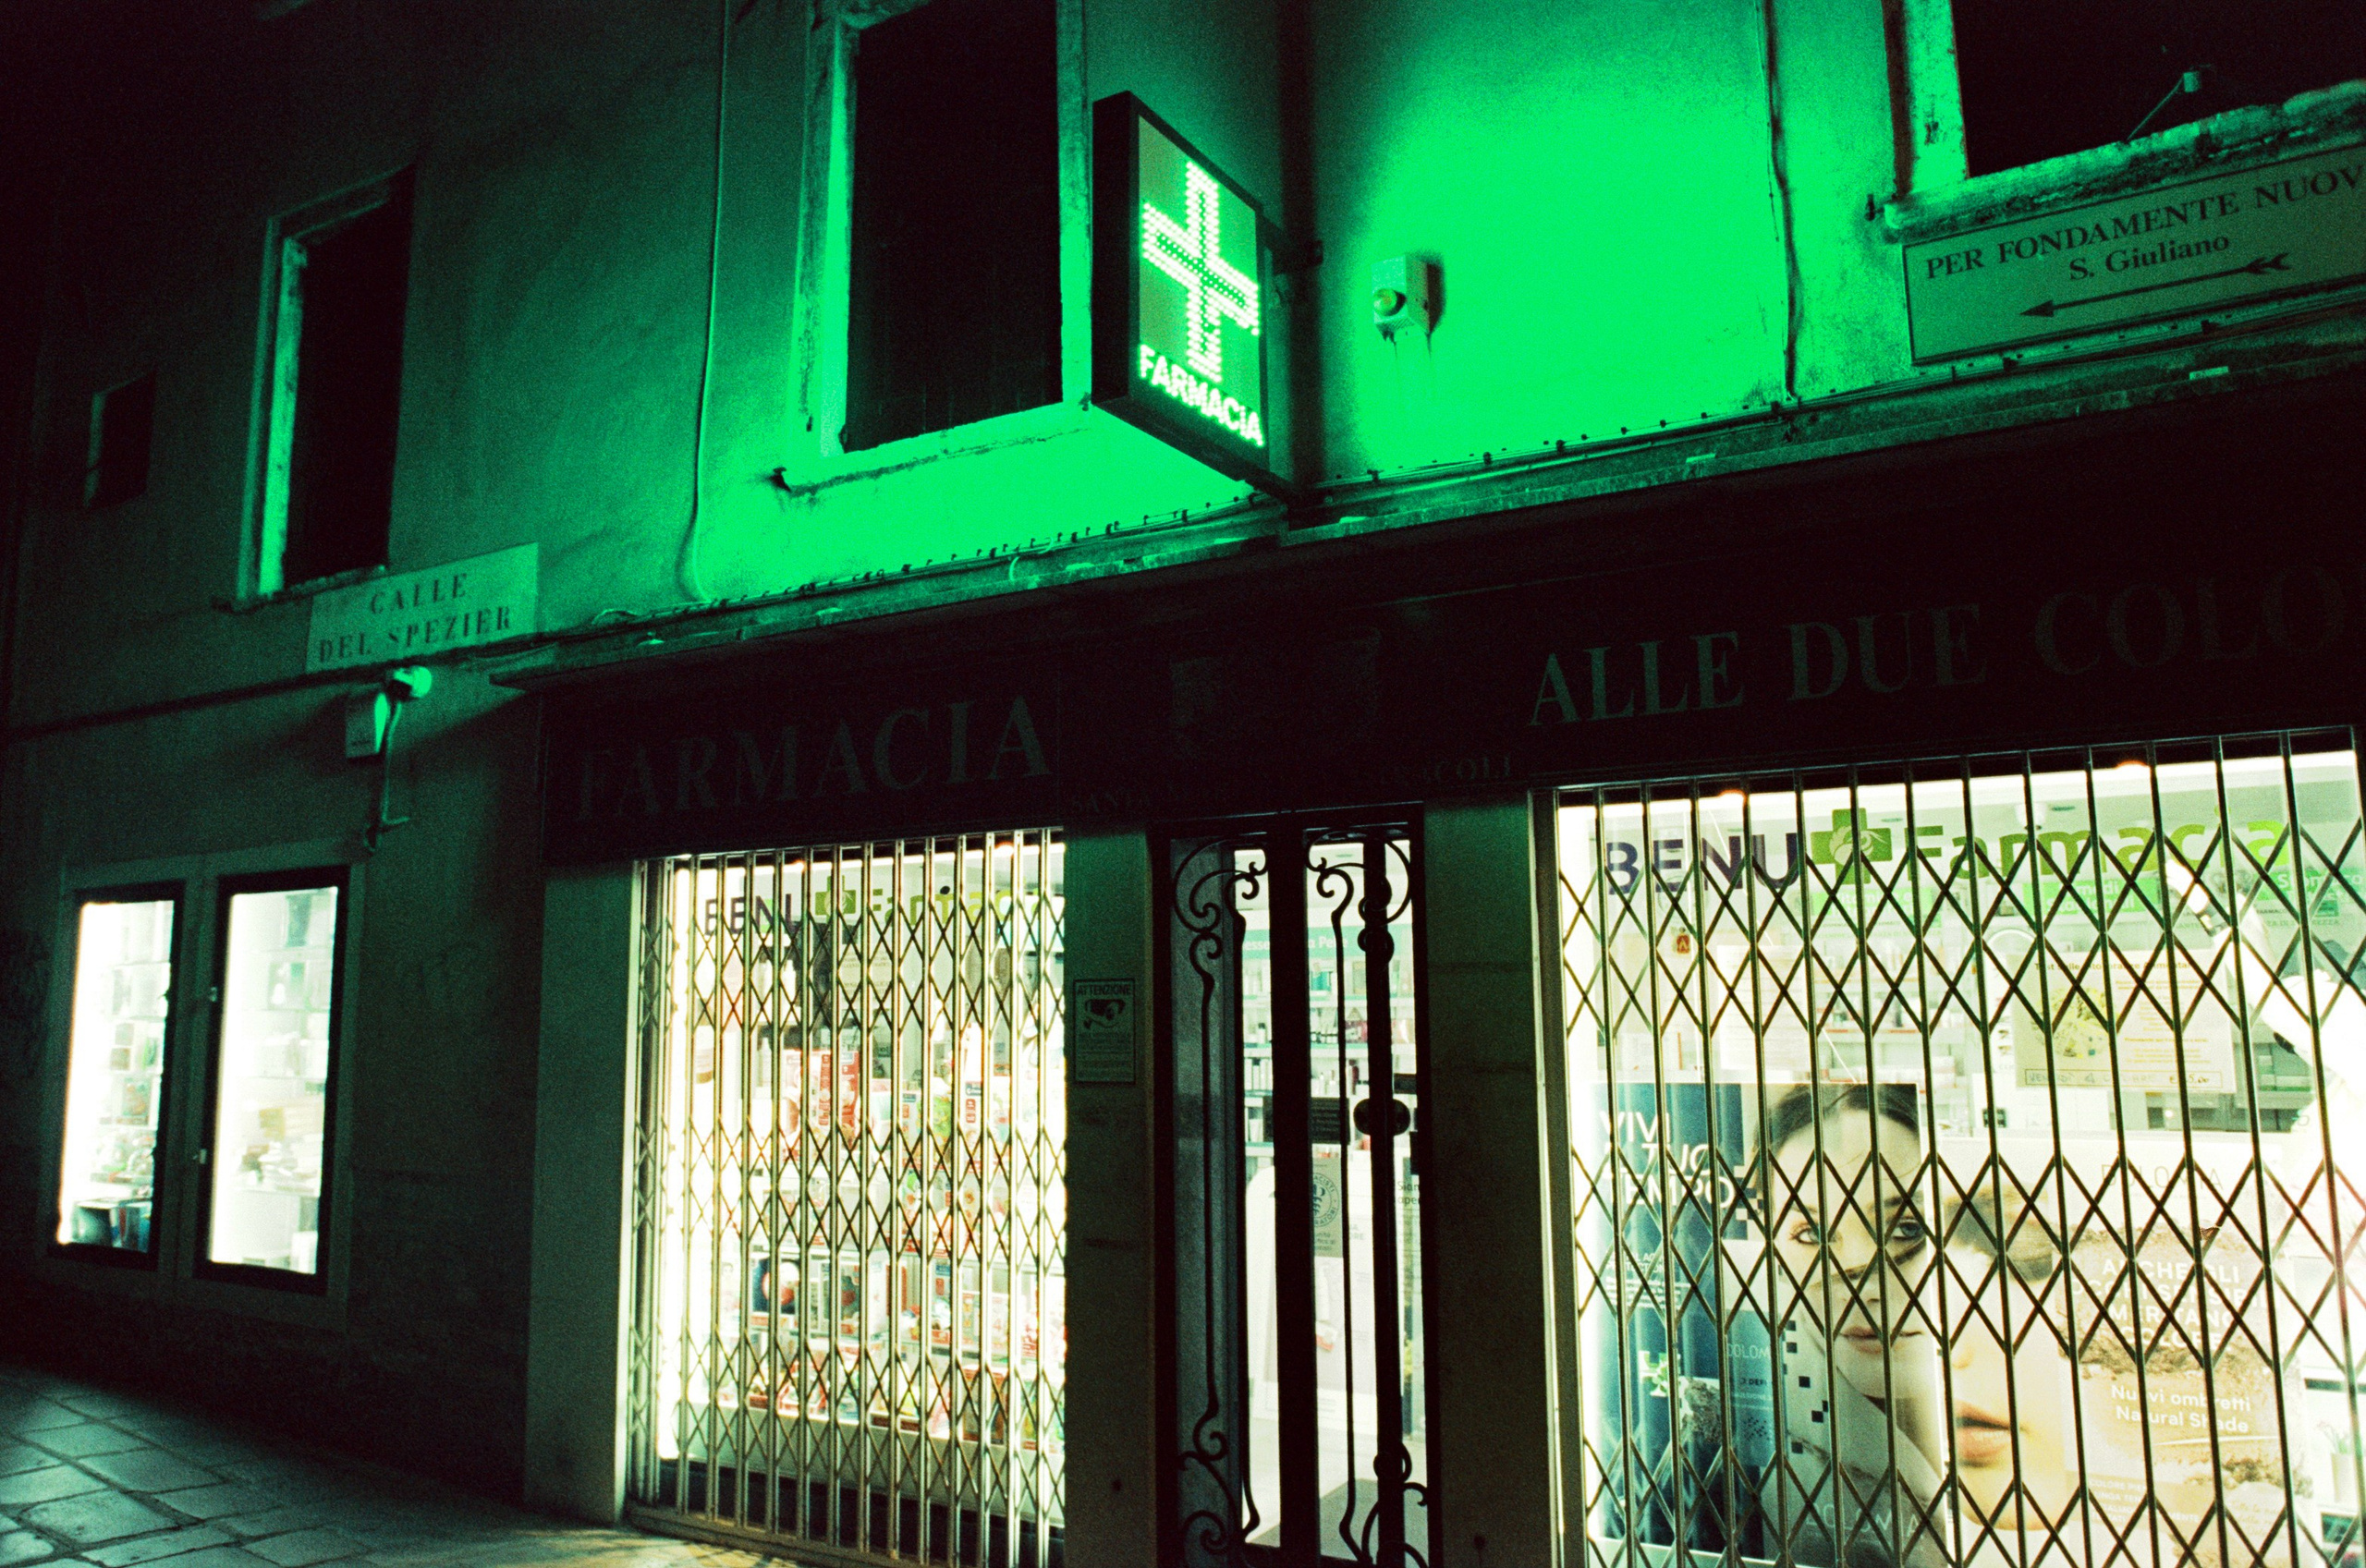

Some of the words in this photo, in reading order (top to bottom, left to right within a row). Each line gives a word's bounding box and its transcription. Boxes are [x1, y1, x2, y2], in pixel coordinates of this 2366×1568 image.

[1925, 245, 1986, 279] PER
[1998, 190, 2240, 266] FONDAMENTE
[2069, 256, 2095, 280] S.
[2106, 233, 2229, 272] Giuliano
[1140, 344, 1265, 447] FARMACIA
[372, 573, 468, 615] CALLE
[319, 632, 370, 662] DEL
[388, 606, 509, 648] SPEZIER
[1528, 630, 1746, 727] ALLE
[1786, 602, 1988, 703] DUE
[575, 694, 1053, 821] FARMACIA
[1605, 833, 1799, 895] BENU
[1077, 983, 1131, 996] ATTENZIONE
[2111, 1384, 2165, 1404] Nuvi
[2116, 1405, 2184, 1427] Naural
